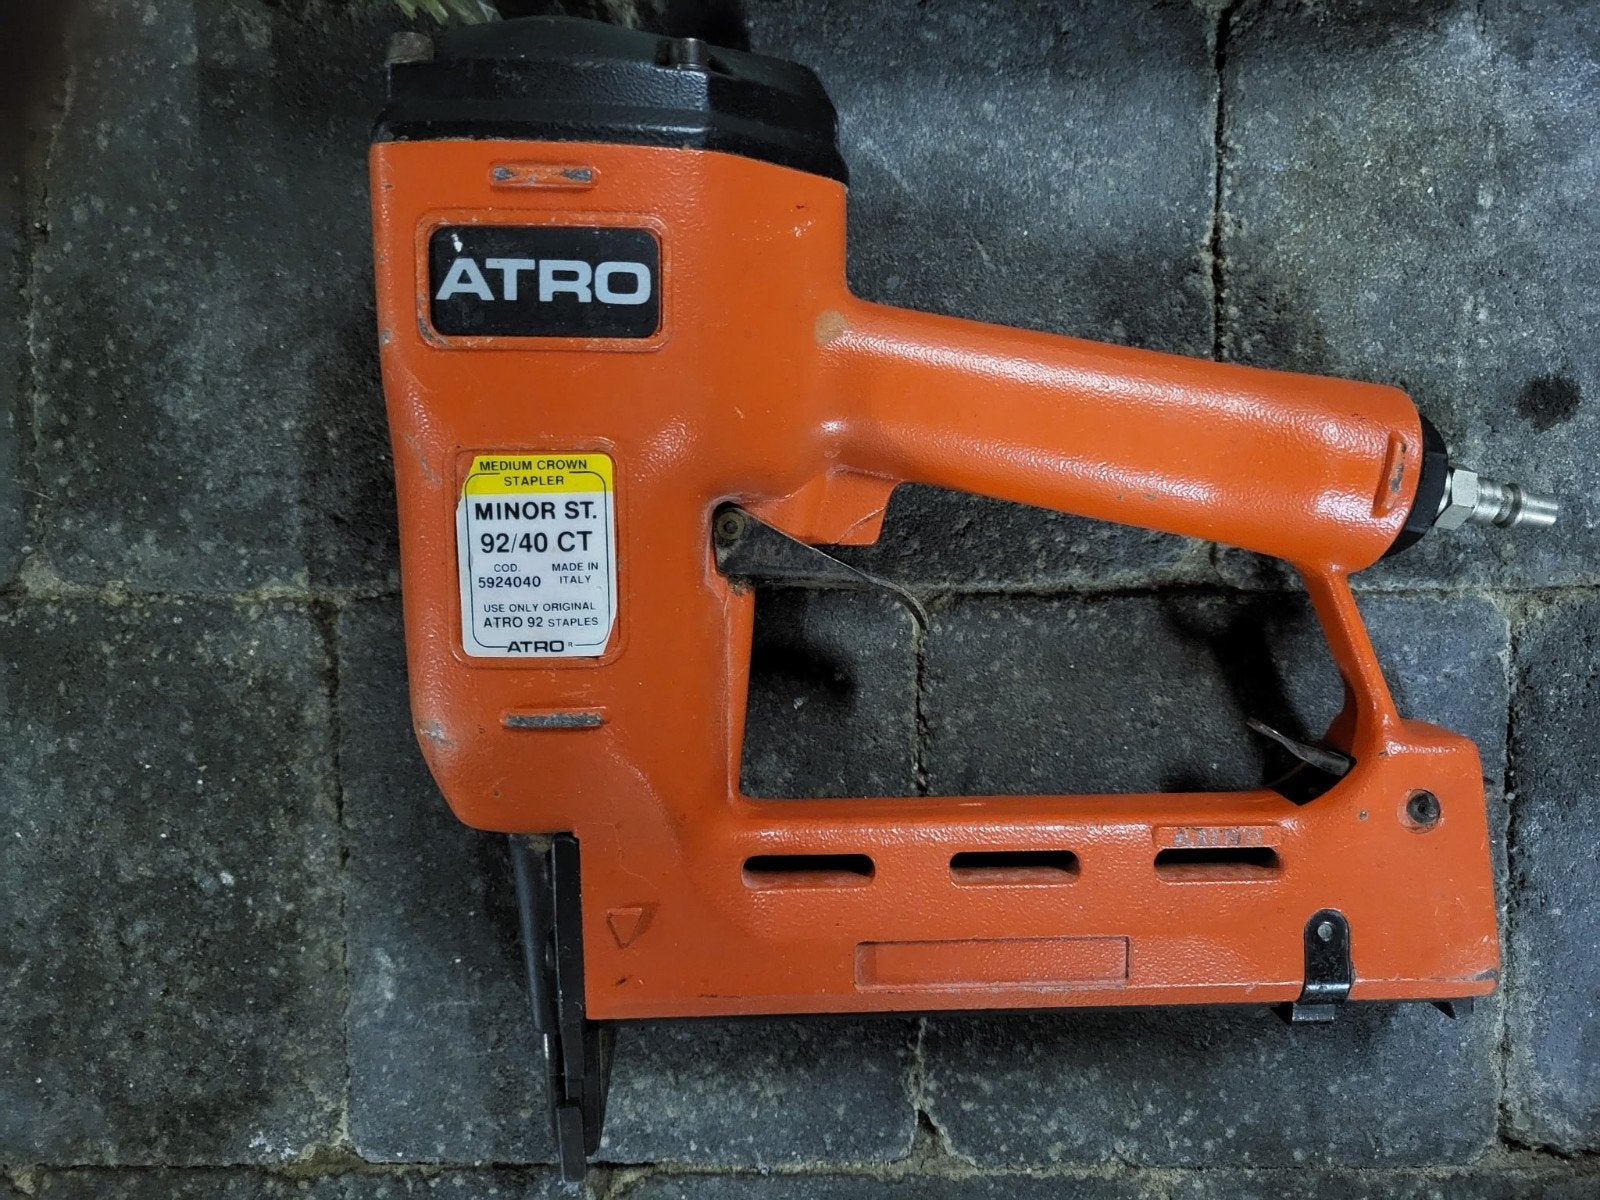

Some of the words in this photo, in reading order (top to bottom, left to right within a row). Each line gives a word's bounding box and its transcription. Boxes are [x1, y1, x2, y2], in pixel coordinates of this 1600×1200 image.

[435, 257, 652, 305] ATRO
[480, 461, 532, 471] MEDIUM
[537, 460, 587, 470] CROWN
[504, 476, 564, 486] STAPLER
[475, 502, 555, 520] MINOR
[565, 501, 597, 519] ST.
[481, 533, 548, 553] 92/40
[558, 531, 592, 551] CT
[494, 564, 520, 572] COD.
[552, 563, 583, 571] MADE
[588, 562, 598, 570] IN
[478, 576, 541, 588] 5924040
[560, 575, 591, 584] ITALY
[484, 604, 505, 612] USE
[509, 604, 538, 612] ONLY
[543, 602, 595, 611] ORIGINAL
[484, 617, 523, 628] ATRO
[528, 617, 543, 627] 92
[548, 617, 598, 627] STAPLES
[507, 641, 564, 652] ATRO
